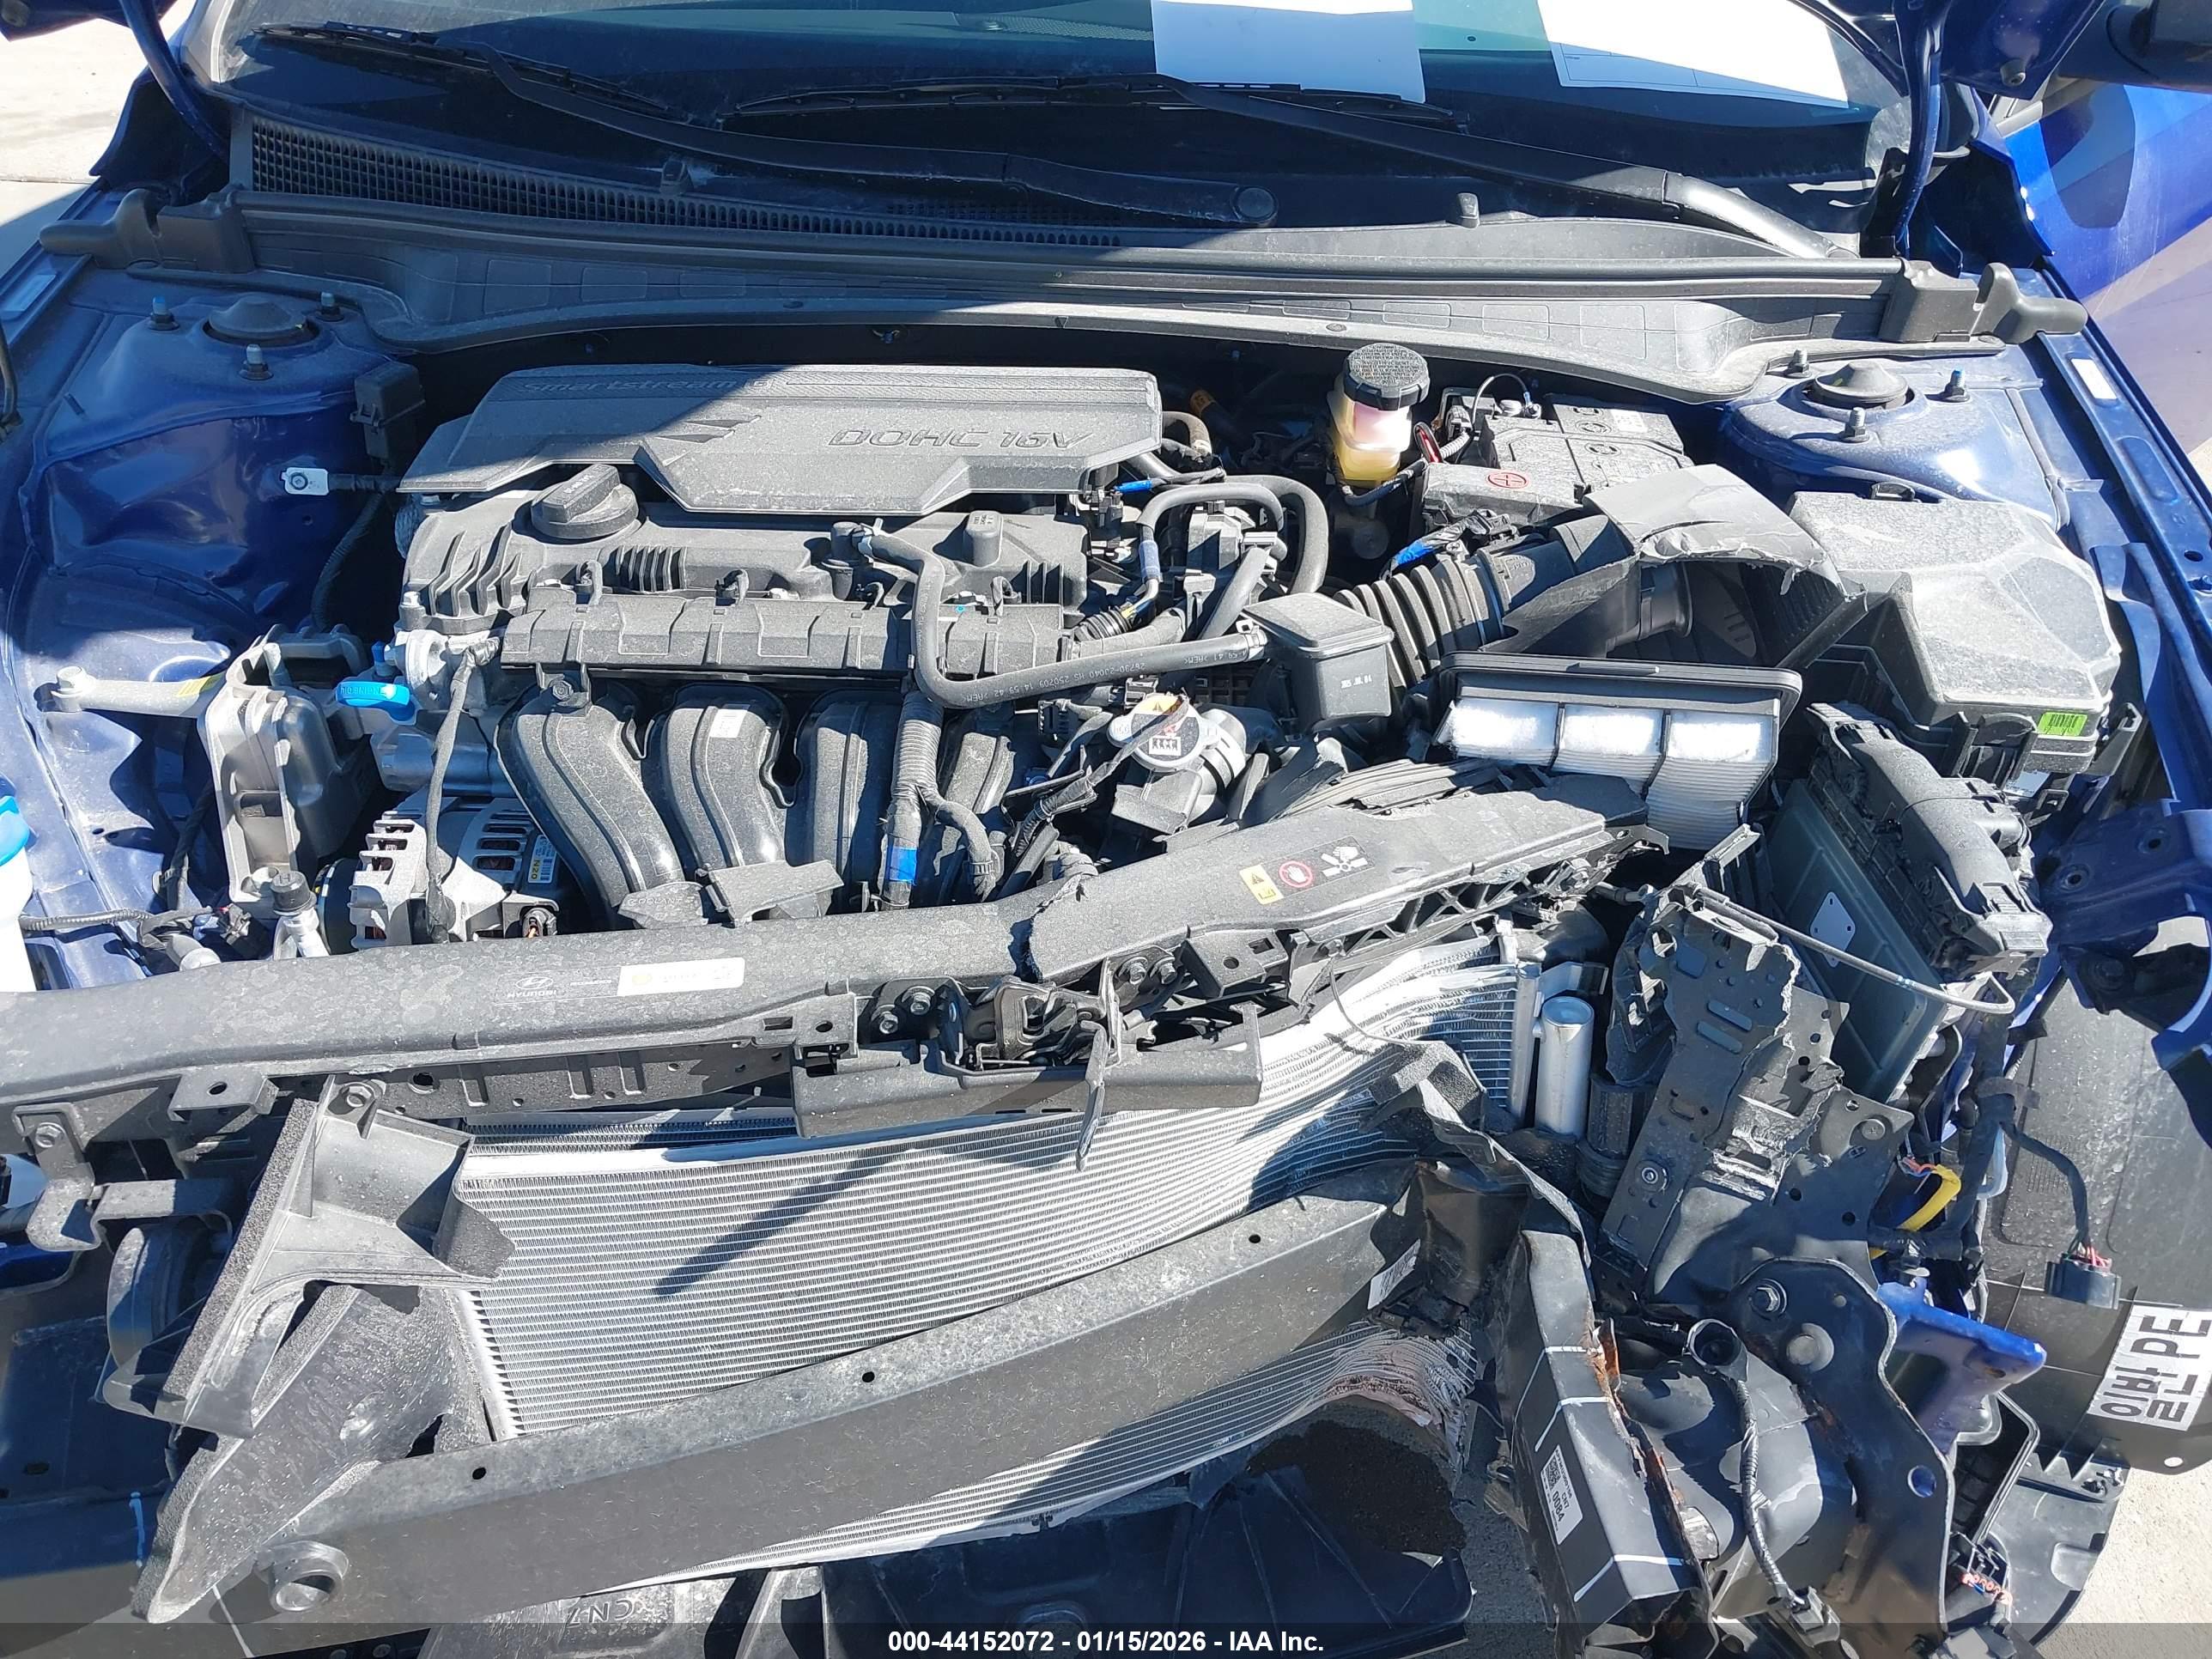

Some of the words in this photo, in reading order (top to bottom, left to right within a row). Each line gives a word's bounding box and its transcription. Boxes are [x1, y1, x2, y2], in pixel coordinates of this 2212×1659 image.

[828, 428, 988, 447] DOHC
[1000, 430, 1094, 448] 16V
[1038, 674, 1071, 689] 250709
[531, 859, 541, 880] N20
[628, 897, 684, 907] COOLANT
[507, 989, 557, 999] HYUNDAI
[2129, 1315, 2212, 1359] PE
[1552, 1490, 1566, 1522] 0084
[1560, 1492, 1571, 1509] CN7
